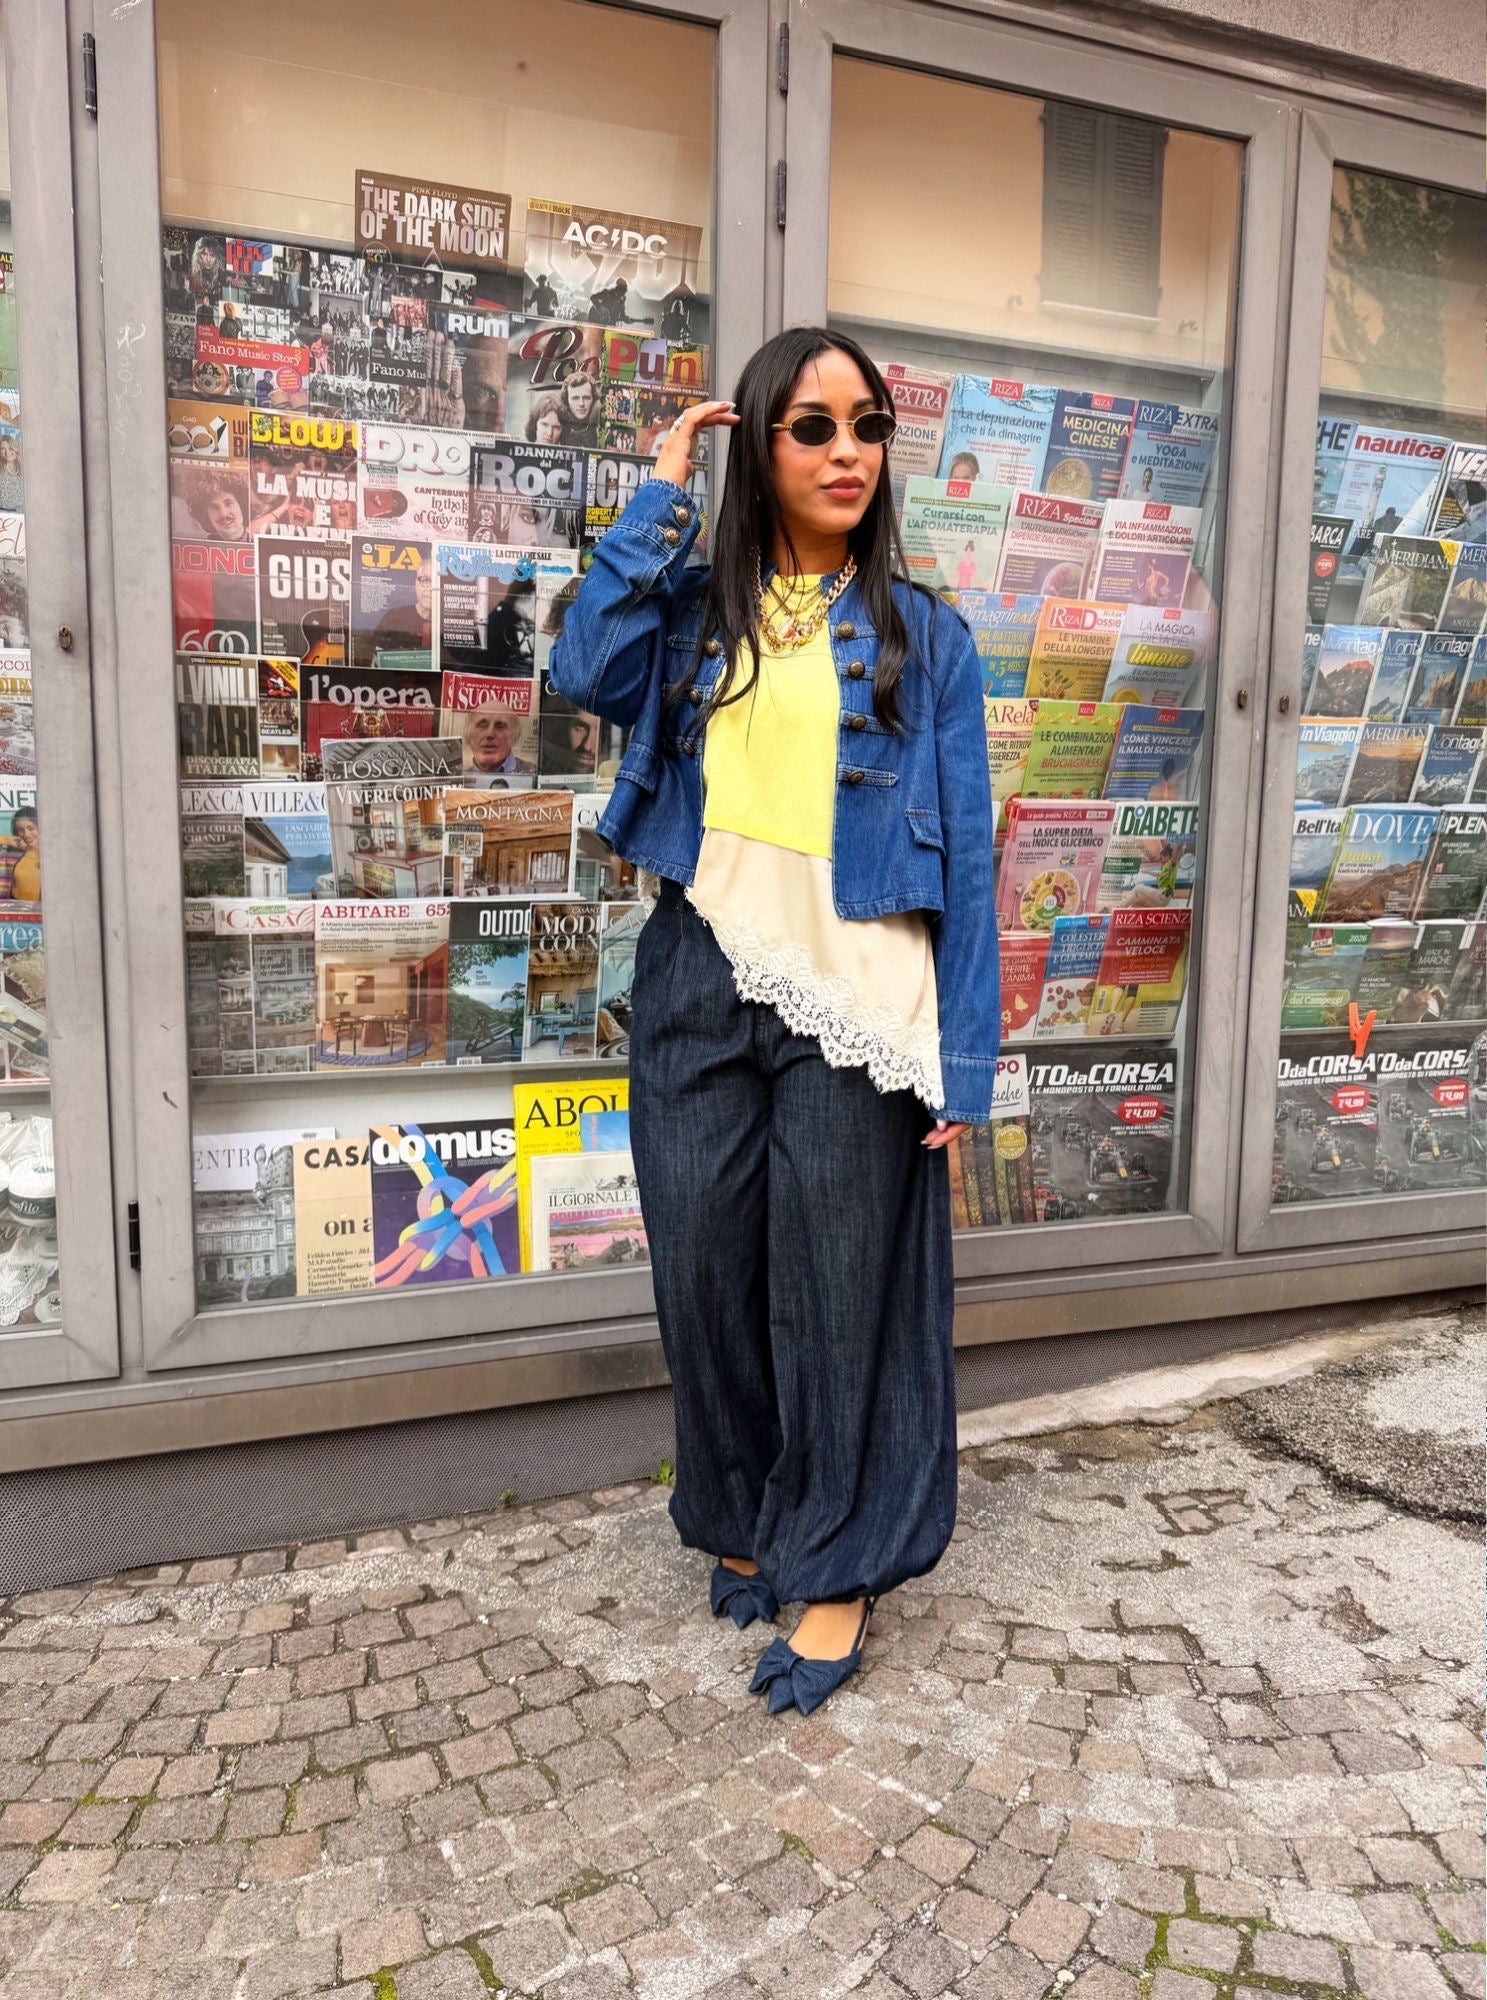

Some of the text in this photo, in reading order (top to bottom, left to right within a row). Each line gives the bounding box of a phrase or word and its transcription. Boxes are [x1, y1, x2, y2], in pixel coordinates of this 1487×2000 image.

[361, 185, 506, 230] THE DARK SIDE
[360, 210, 504, 258] OF THE MOON
[199, 340, 301, 366] Fano Music Story
[371, 362, 405, 377] Fano
[891, 383, 943, 409] EXTRA
[994, 384, 1019, 398] RIZA
[960, 407, 1047, 430] La depurazione
[1062, 416, 1130, 437] MEDICINA
[1139, 404, 1219, 432] RIZA EXTRA
[960, 423, 977, 436] che
[998, 428, 1042, 445] dimagrire
[1069, 432, 1119, 450] CINESE
[514, 446, 577, 461] DANNATI
[1155, 443, 1187, 459] YOGA
[1354, 433, 1447, 460] nautica
[540, 460, 552, 468] del
[1139, 455, 1206, 473] MEDITAZIONE
[257, 472, 289, 497] LA
[296, 476, 357, 502] MUSI
[949, 486, 969, 497] RIZA
[922, 507, 985, 524] Curarsi con
[1021, 497, 1061, 522] RIZA
[1063, 513, 1099, 528] Speciale
[1146, 507, 1168, 519] RIZA
[907, 519, 998, 537] L'AROMATERAPIA
[1114, 520, 1193, 536] VIA INFIAMMAZIONI
[1115, 531, 1146, 543] DOLORI
[269, 554, 350, 601] GIBS
[1154, 622, 1195, 636] MAGICA
[1058, 633, 1111, 646] LE VITAMINE
[1044, 643, 1072, 655] DELLA
[1129, 644, 1188, 668] limone
[458, 686, 529, 712] SUONARE
[180, 703, 256, 757] RARI
[1040, 731, 1052, 742] LE
[1123, 734, 1150, 744] COME
[1050, 745, 1104, 756] ALIMENTARI
[339, 757, 450, 779] TOSCANA
[456, 805, 564, 822] MONTAGNA
[1033, 827, 1093, 838] LA SUPER DIETA
[1348, 813, 1436, 845] DOVE
[1060, 838, 1104, 848] GLICEMICO
[320, 905, 410, 918] ABITARE
[1115, 914, 1144, 926] RIZA
[1116, 935, 1181, 946] CAMMINATA
[1125, 945, 1166, 957] VELOCE
[1041, 1085, 1094, 1094] MONOPOSTO
[1105, 1084, 1144, 1093] FORMULA
[372, 1125, 516, 1166] domus
[563, 1190, 633, 1206] GIORNALE
[324, 1217, 356, 1237] on
